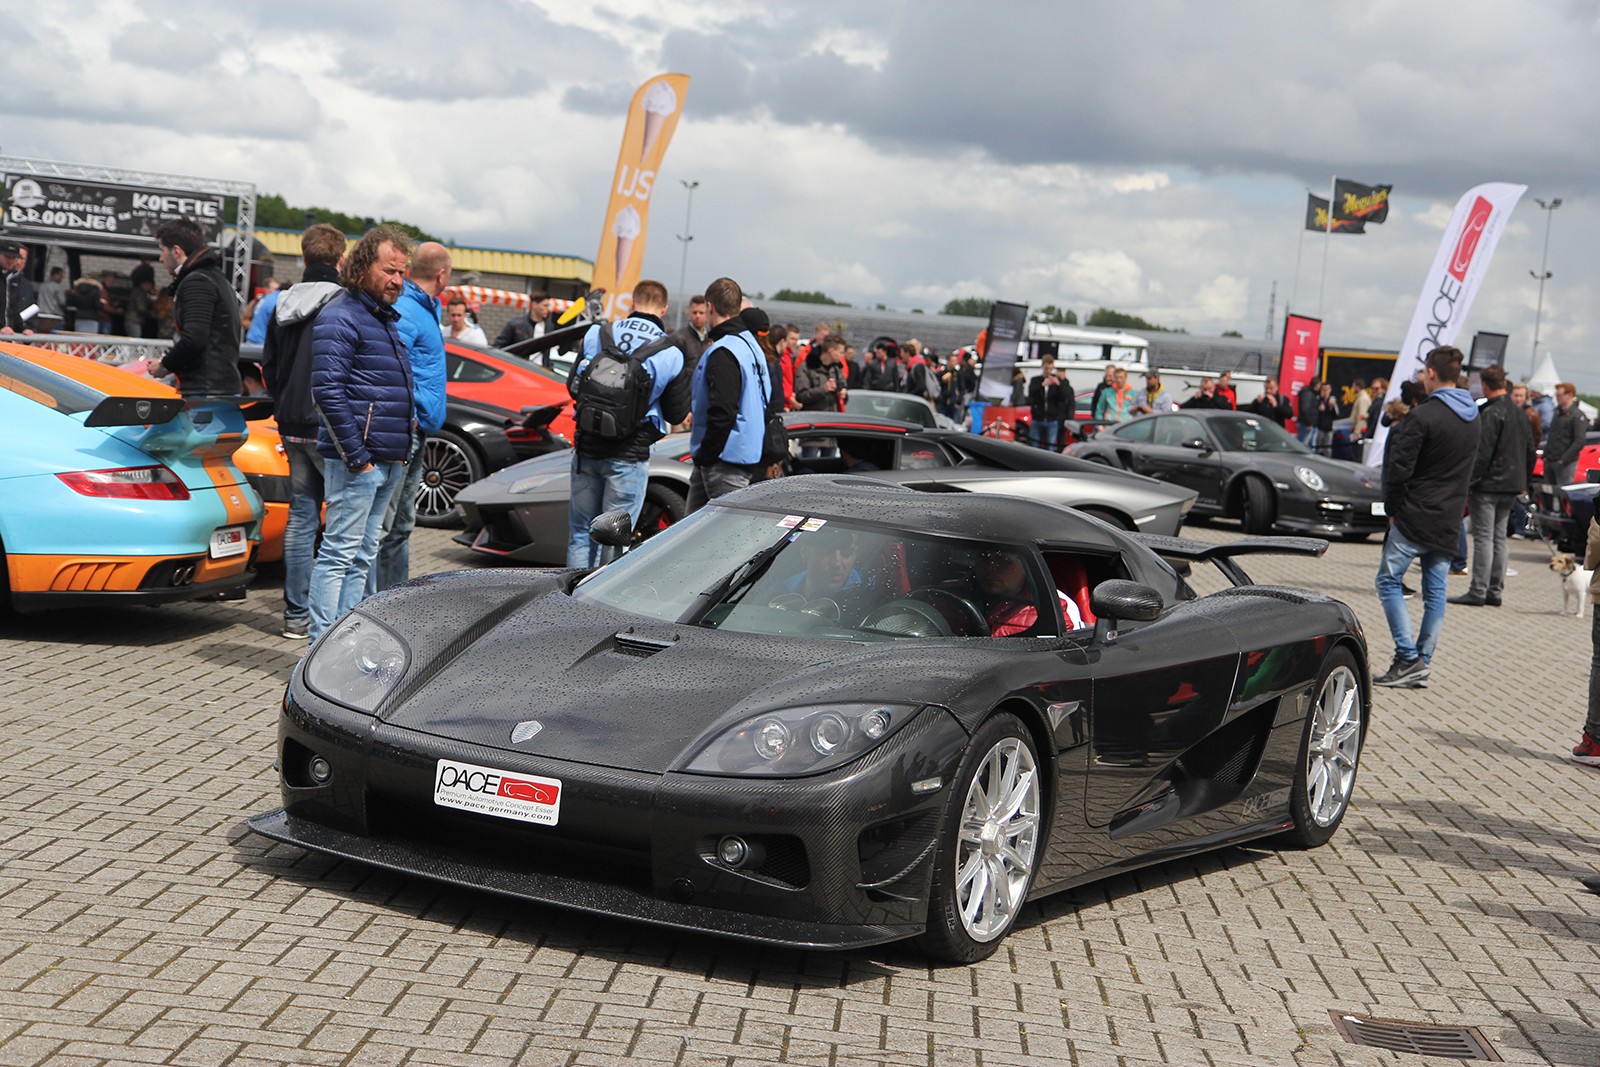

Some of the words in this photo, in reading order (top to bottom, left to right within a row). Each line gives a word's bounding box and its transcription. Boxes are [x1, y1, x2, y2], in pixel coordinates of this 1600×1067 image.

[617, 164, 655, 200] IJS
[132, 192, 219, 217] KOFFIE
[9, 205, 118, 232] BROODJES
[616, 320, 664, 337] MEDIA
[440, 788, 467, 800] Premium
[468, 794, 504, 806] Automotive
[505, 800, 534, 812] Concept
[535, 806, 554, 814] Esser
[440, 796, 552, 821] www.pace-germany.com
